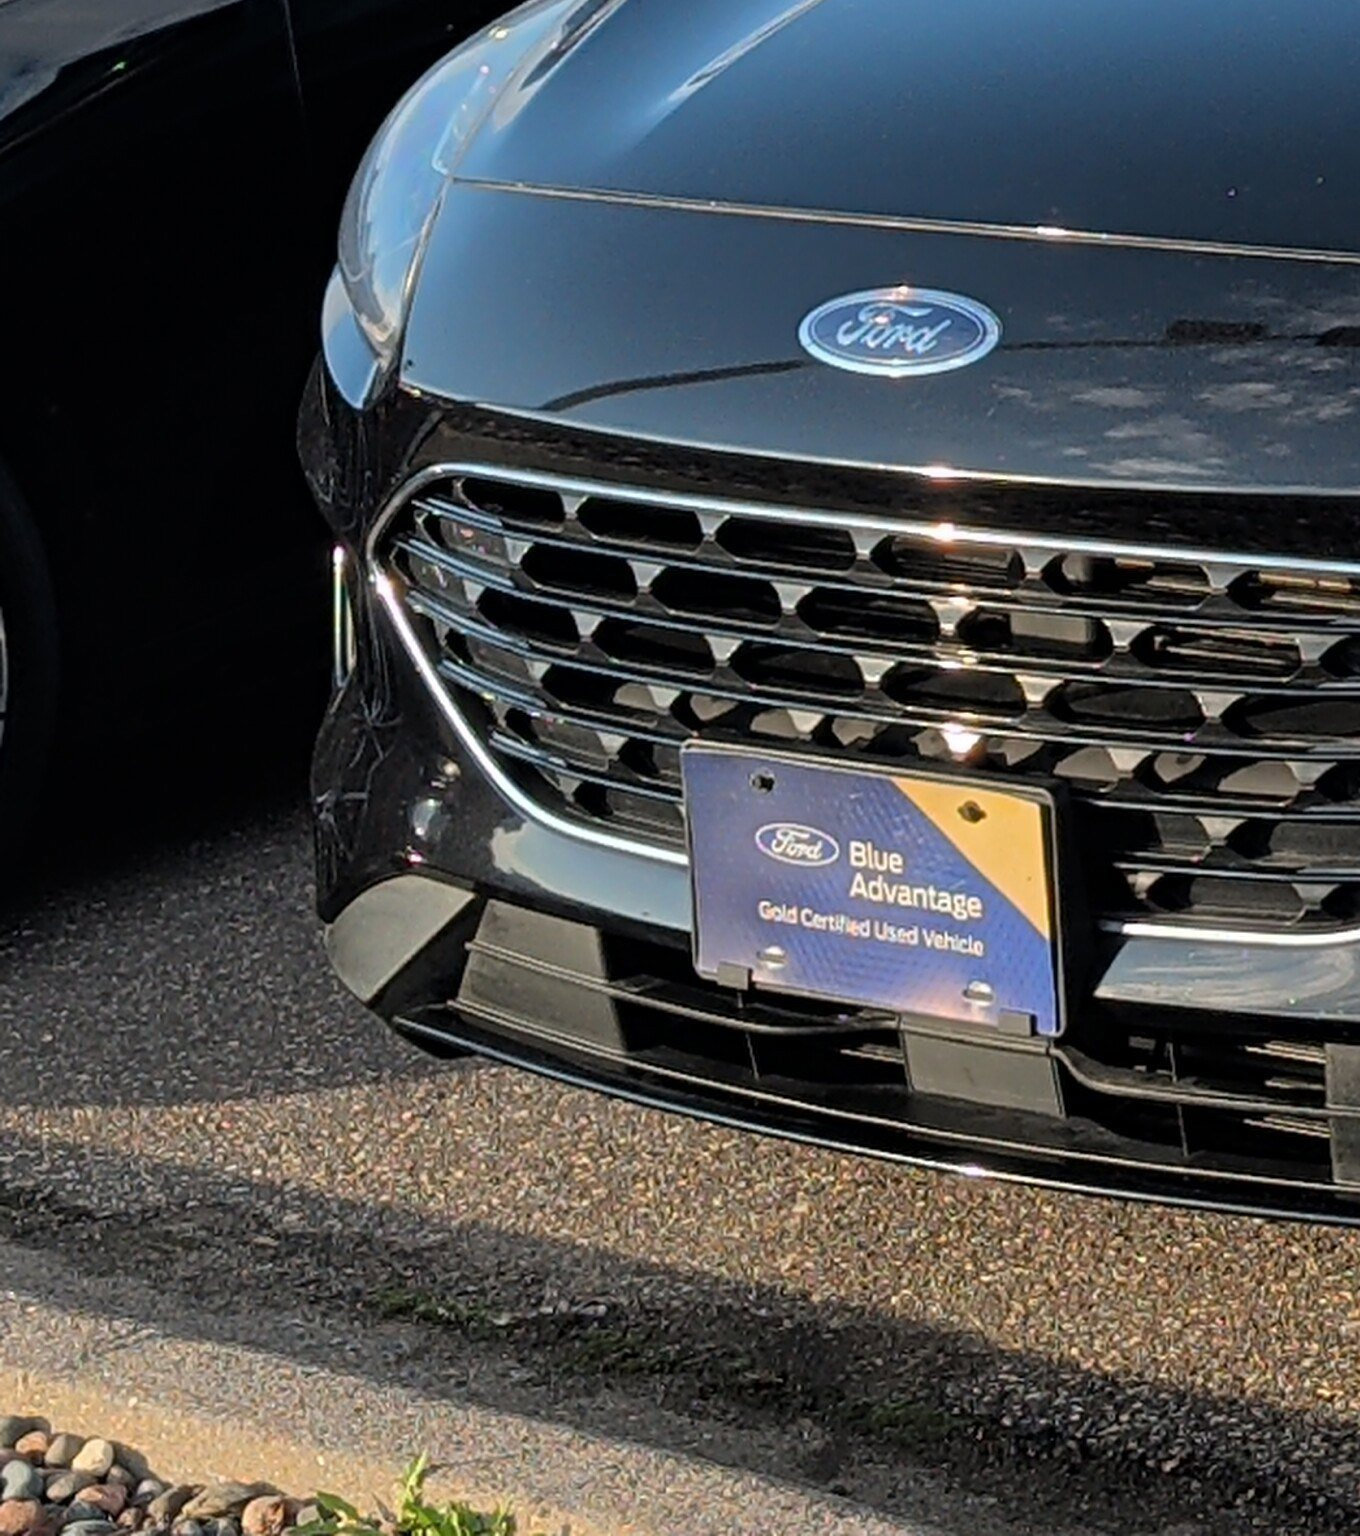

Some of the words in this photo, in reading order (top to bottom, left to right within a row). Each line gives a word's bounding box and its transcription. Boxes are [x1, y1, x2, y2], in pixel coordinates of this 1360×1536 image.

[836, 302, 951, 354] Ford
[772, 827, 823, 860] Ford
[849, 840, 903, 874] Blue
[849, 872, 983, 920] Advantage
[758, 900, 798, 924] Gold
[800, 907, 870, 937] Certified
[874, 921, 919, 946] Used
[922, 928, 984, 958] Vehicle
